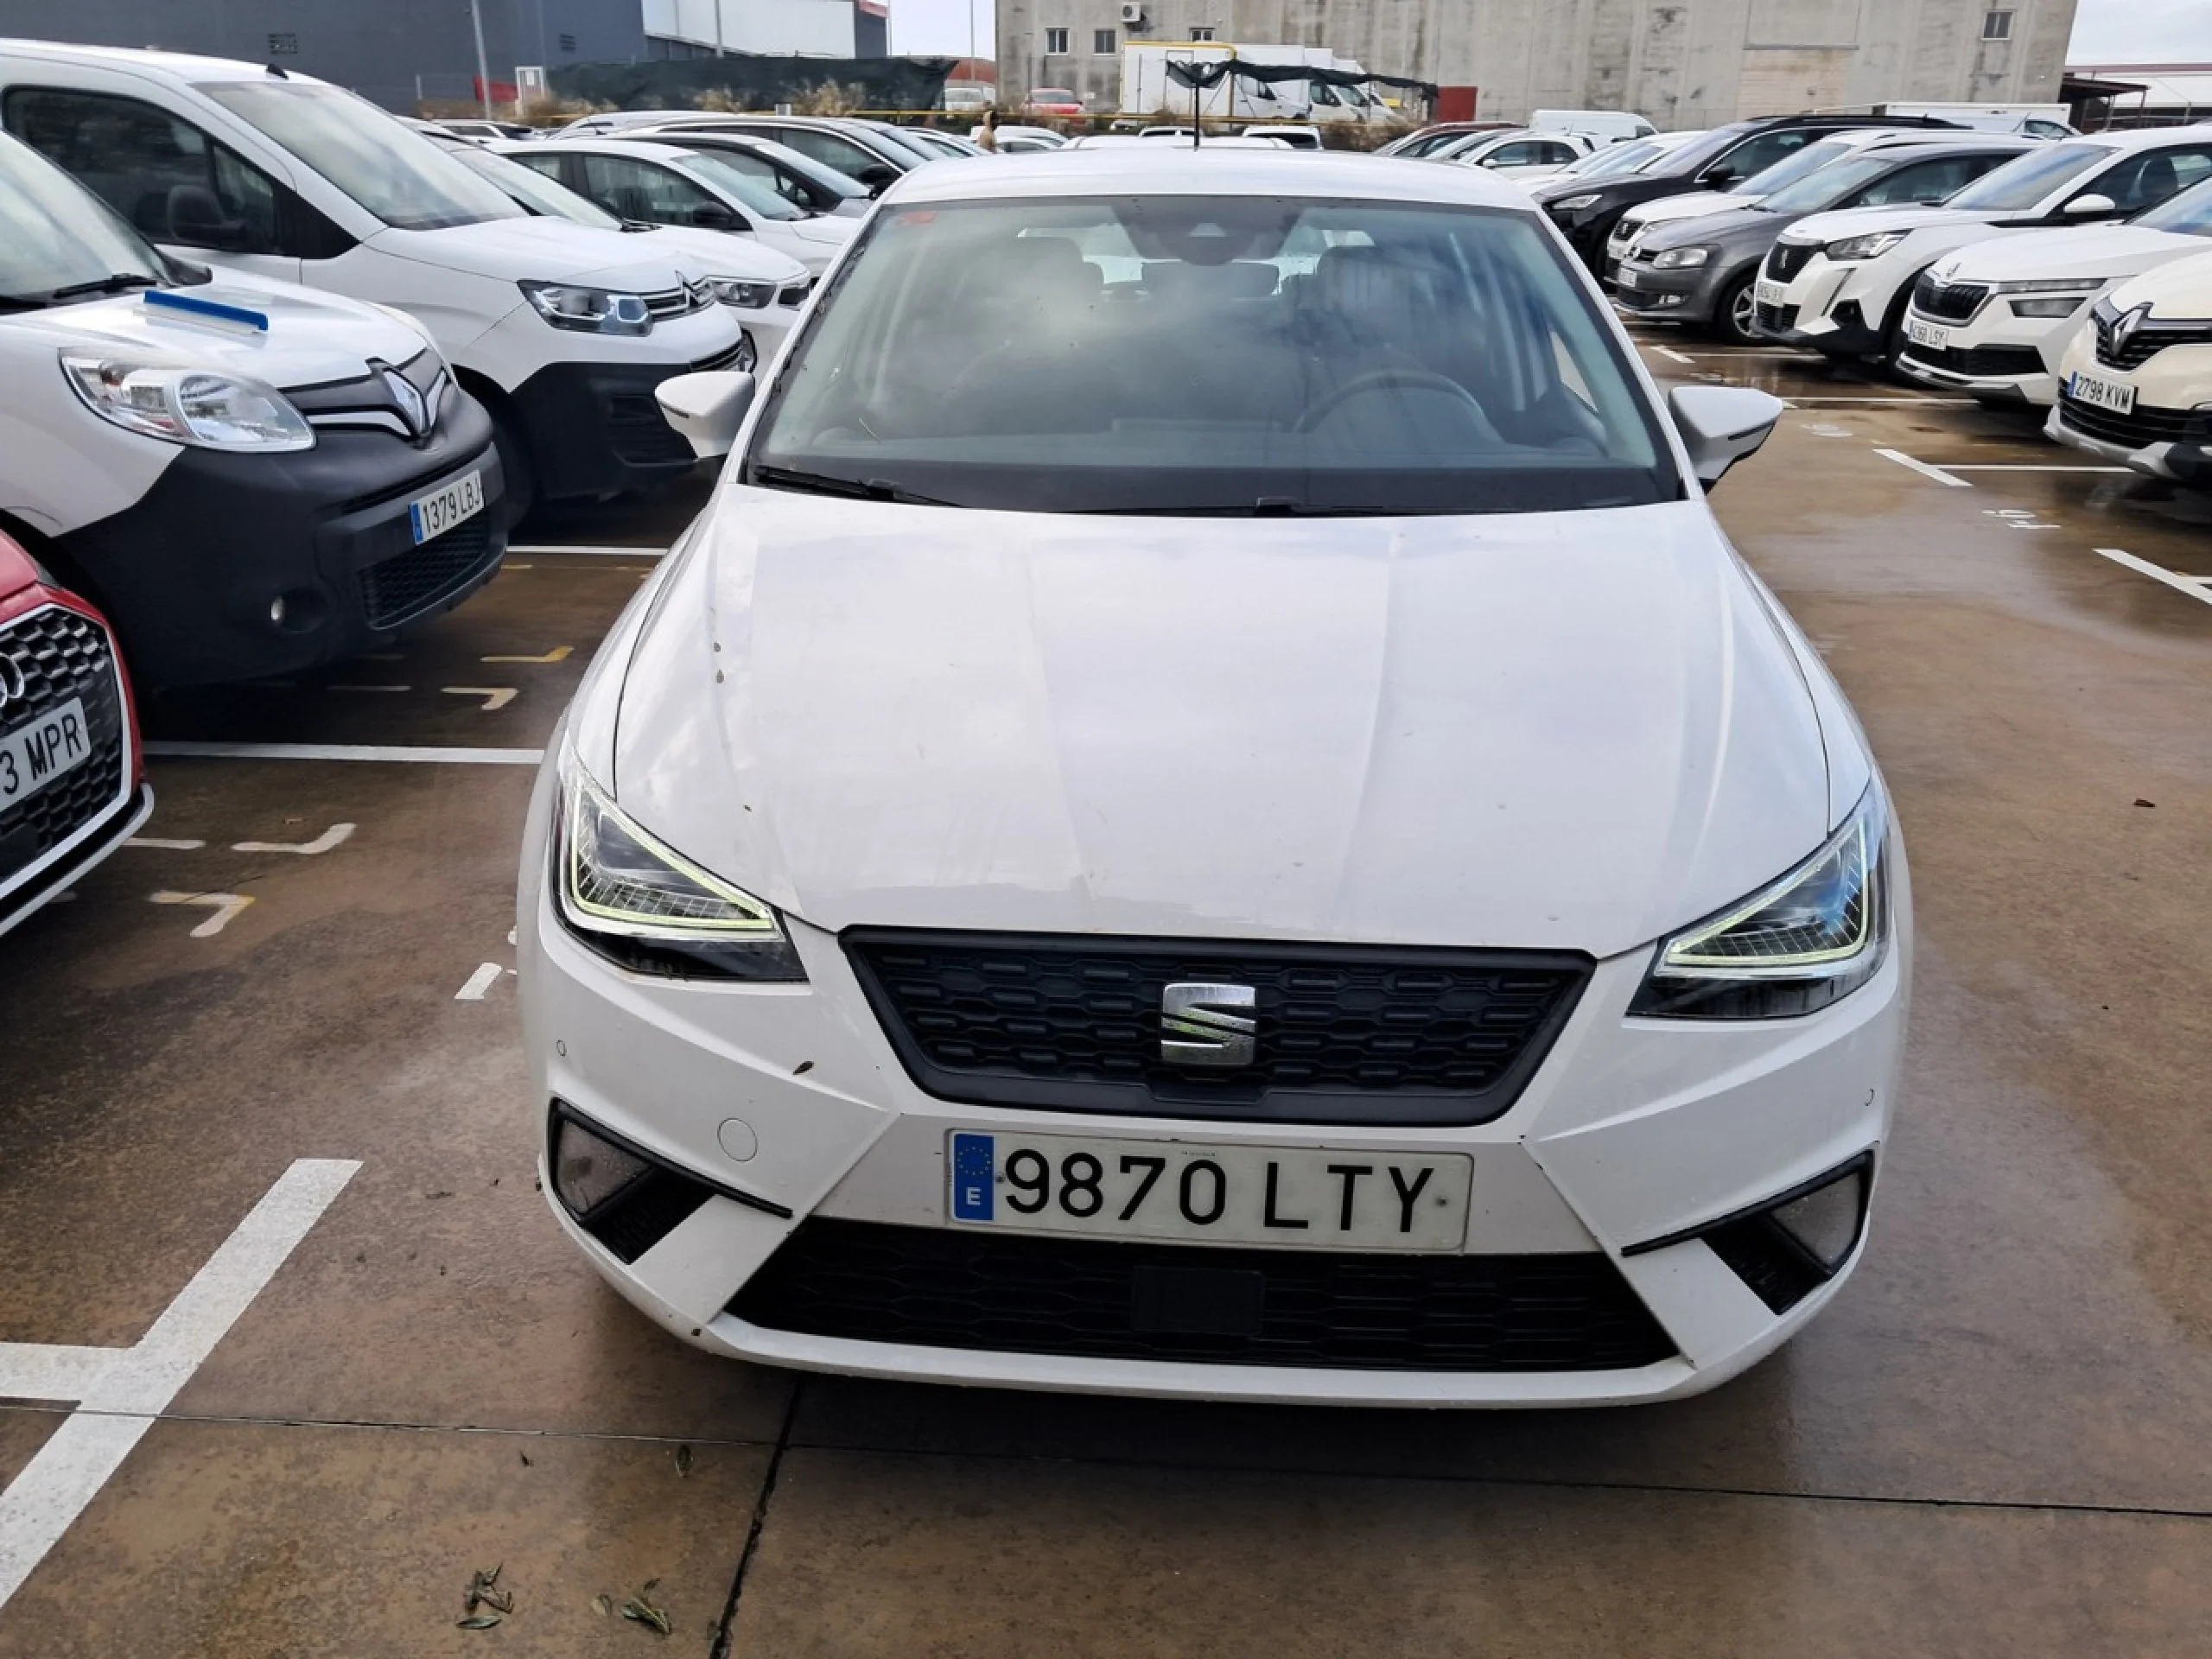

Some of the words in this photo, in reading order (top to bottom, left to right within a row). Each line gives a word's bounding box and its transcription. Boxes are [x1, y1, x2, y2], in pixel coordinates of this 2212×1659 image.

[2075, 376, 2103, 402] 2798
[2105, 385, 2130, 409] KVM
[423, 492, 457, 534] 1379
[457, 476, 480, 514] LBJ
[24, 713, 82, 781] MPR
[965, 1186, 982, 1205] E
[1005, 1148, 1227, 1225] 9870
[1262, 1160, 1434, 1233] LTY
